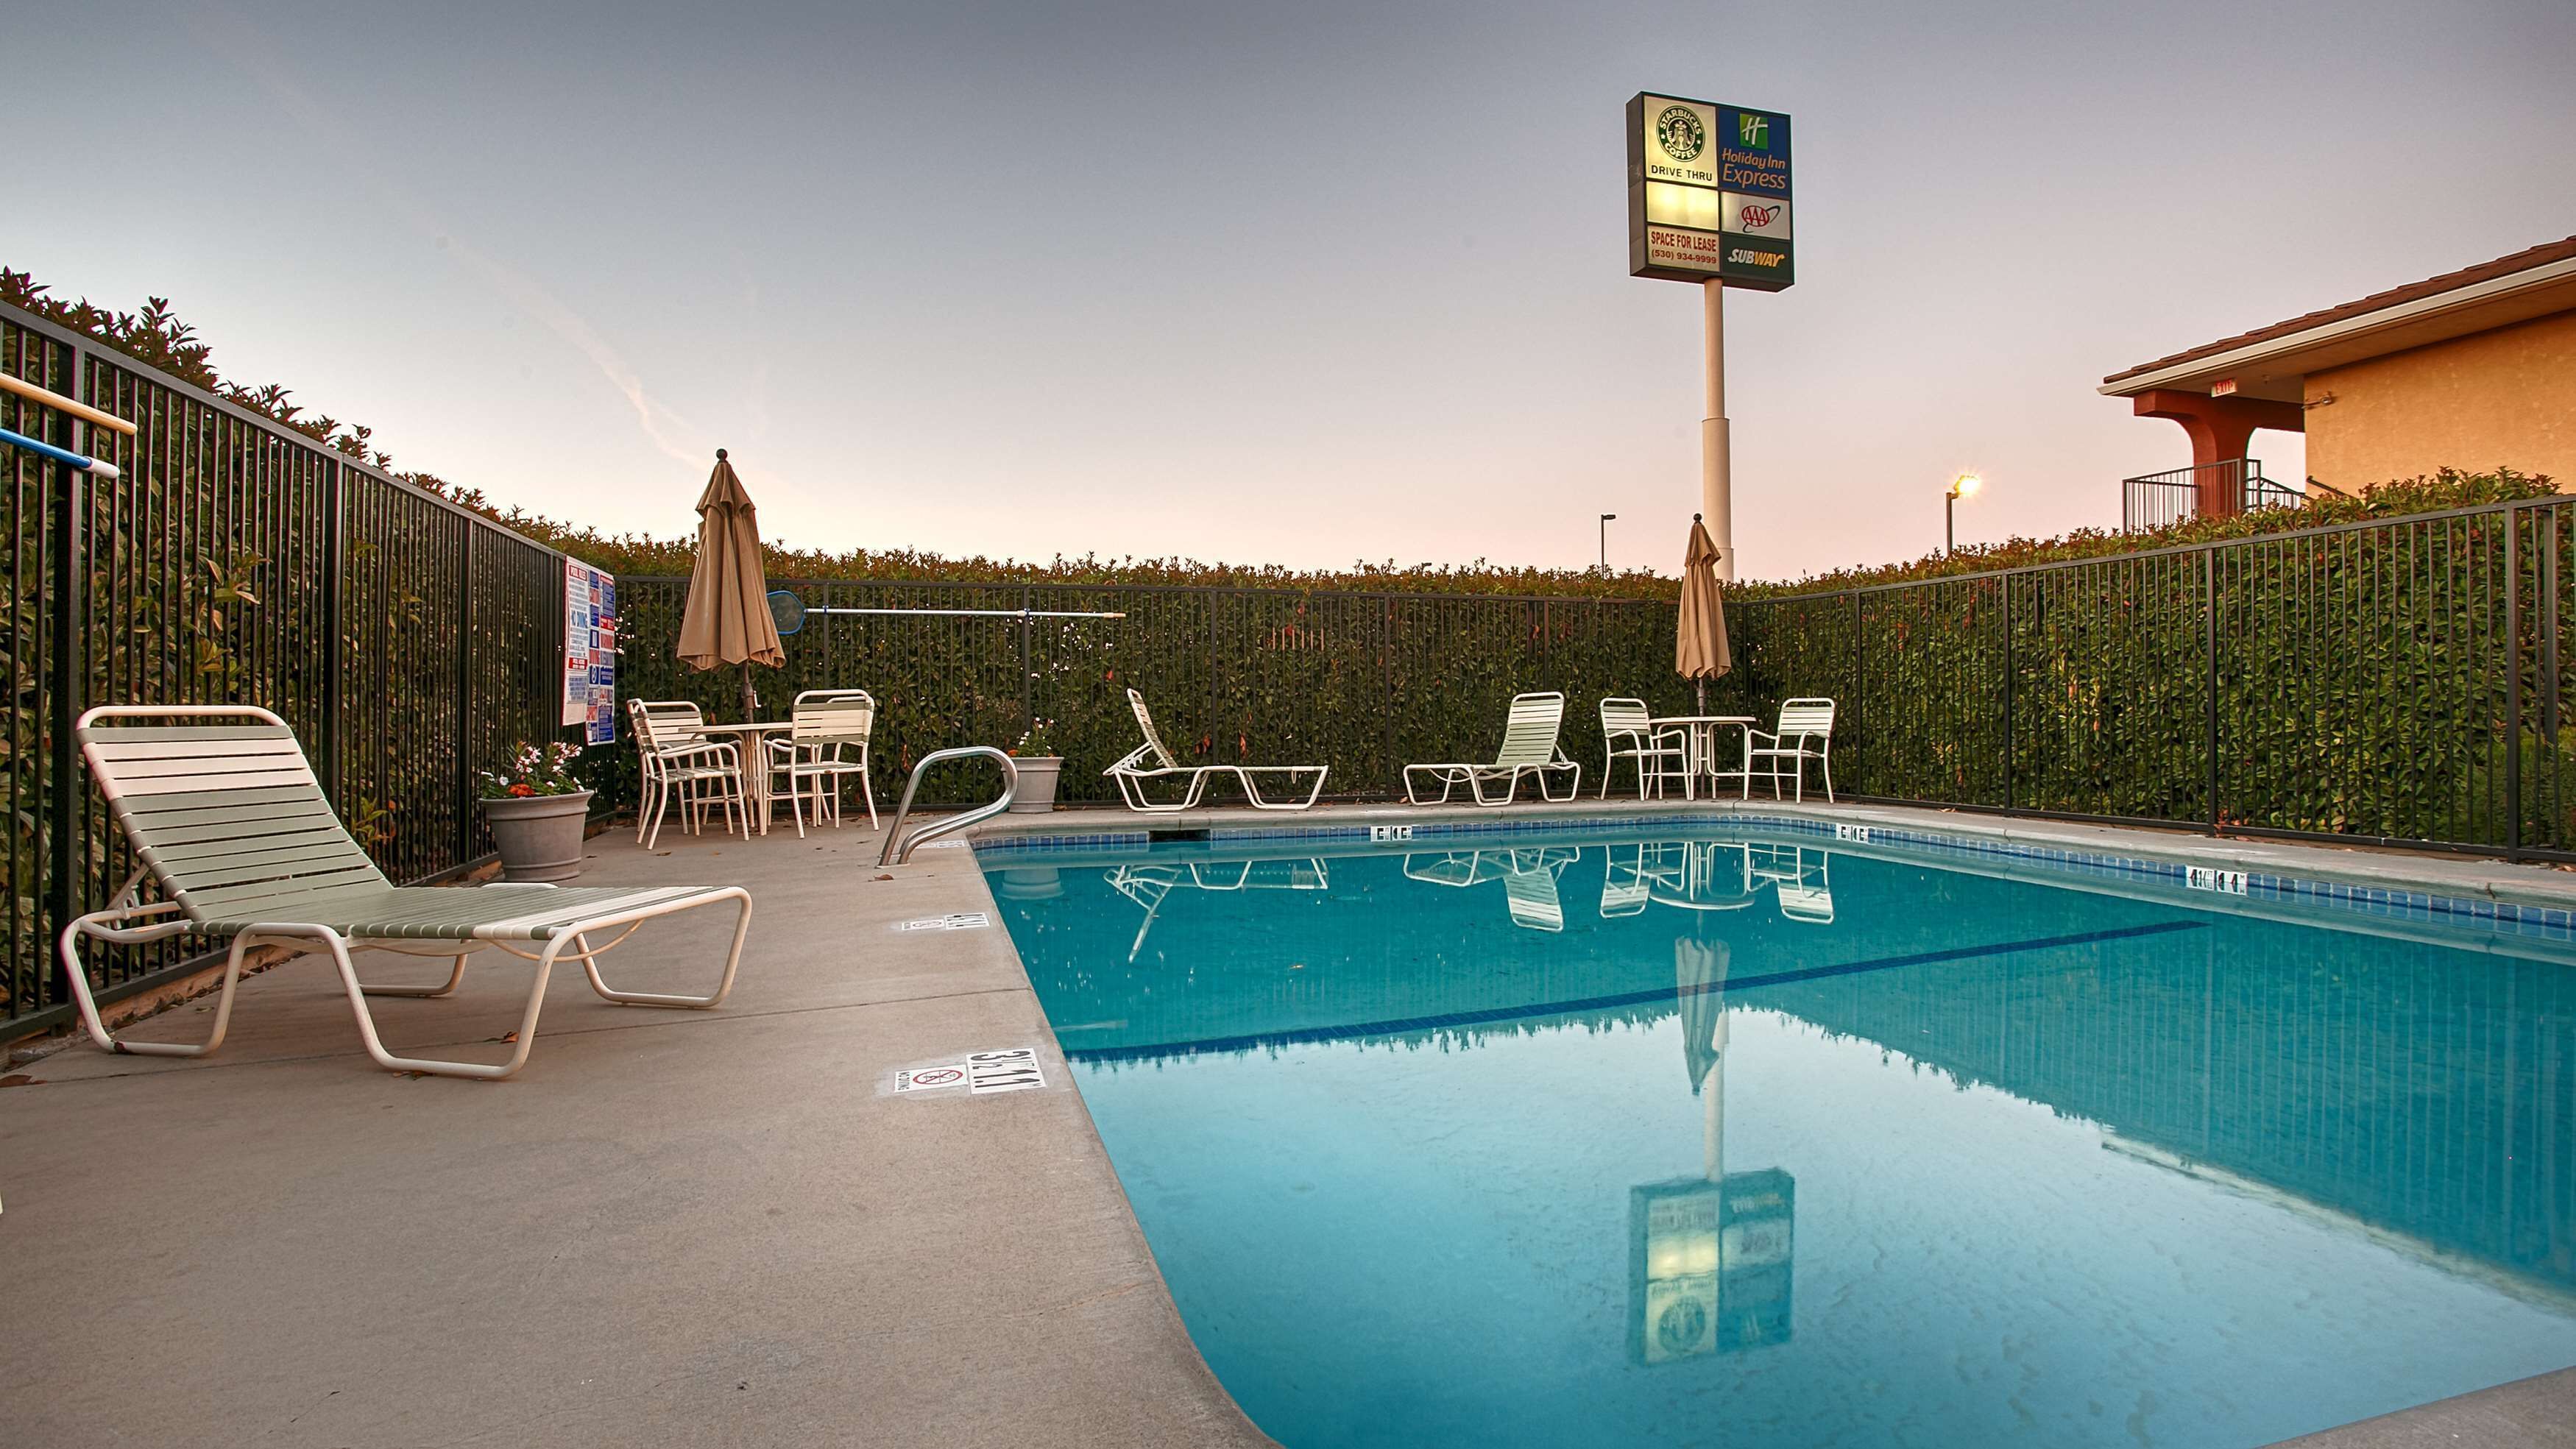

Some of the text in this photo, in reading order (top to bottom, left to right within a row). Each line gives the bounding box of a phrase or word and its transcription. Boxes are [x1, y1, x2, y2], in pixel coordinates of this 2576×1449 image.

[1659, 109, 1702, 135] STARBUCKS
[1664, 142, 1697, 160] COFFEE
[1722, 148, 1786, 169] Holiday Inn
[1651, 164, 1713, 182] DRIVE THRU
[1722, 163, 1786, 189] Express
[1744, 208, 1767, 224] AAA
[1651, 230, 1716, 252] SPACE FOR LEASE
[1651, 249, 1717, 264] (530) 934-9999
[1727, 248, 1786, 268] SUBWAY
